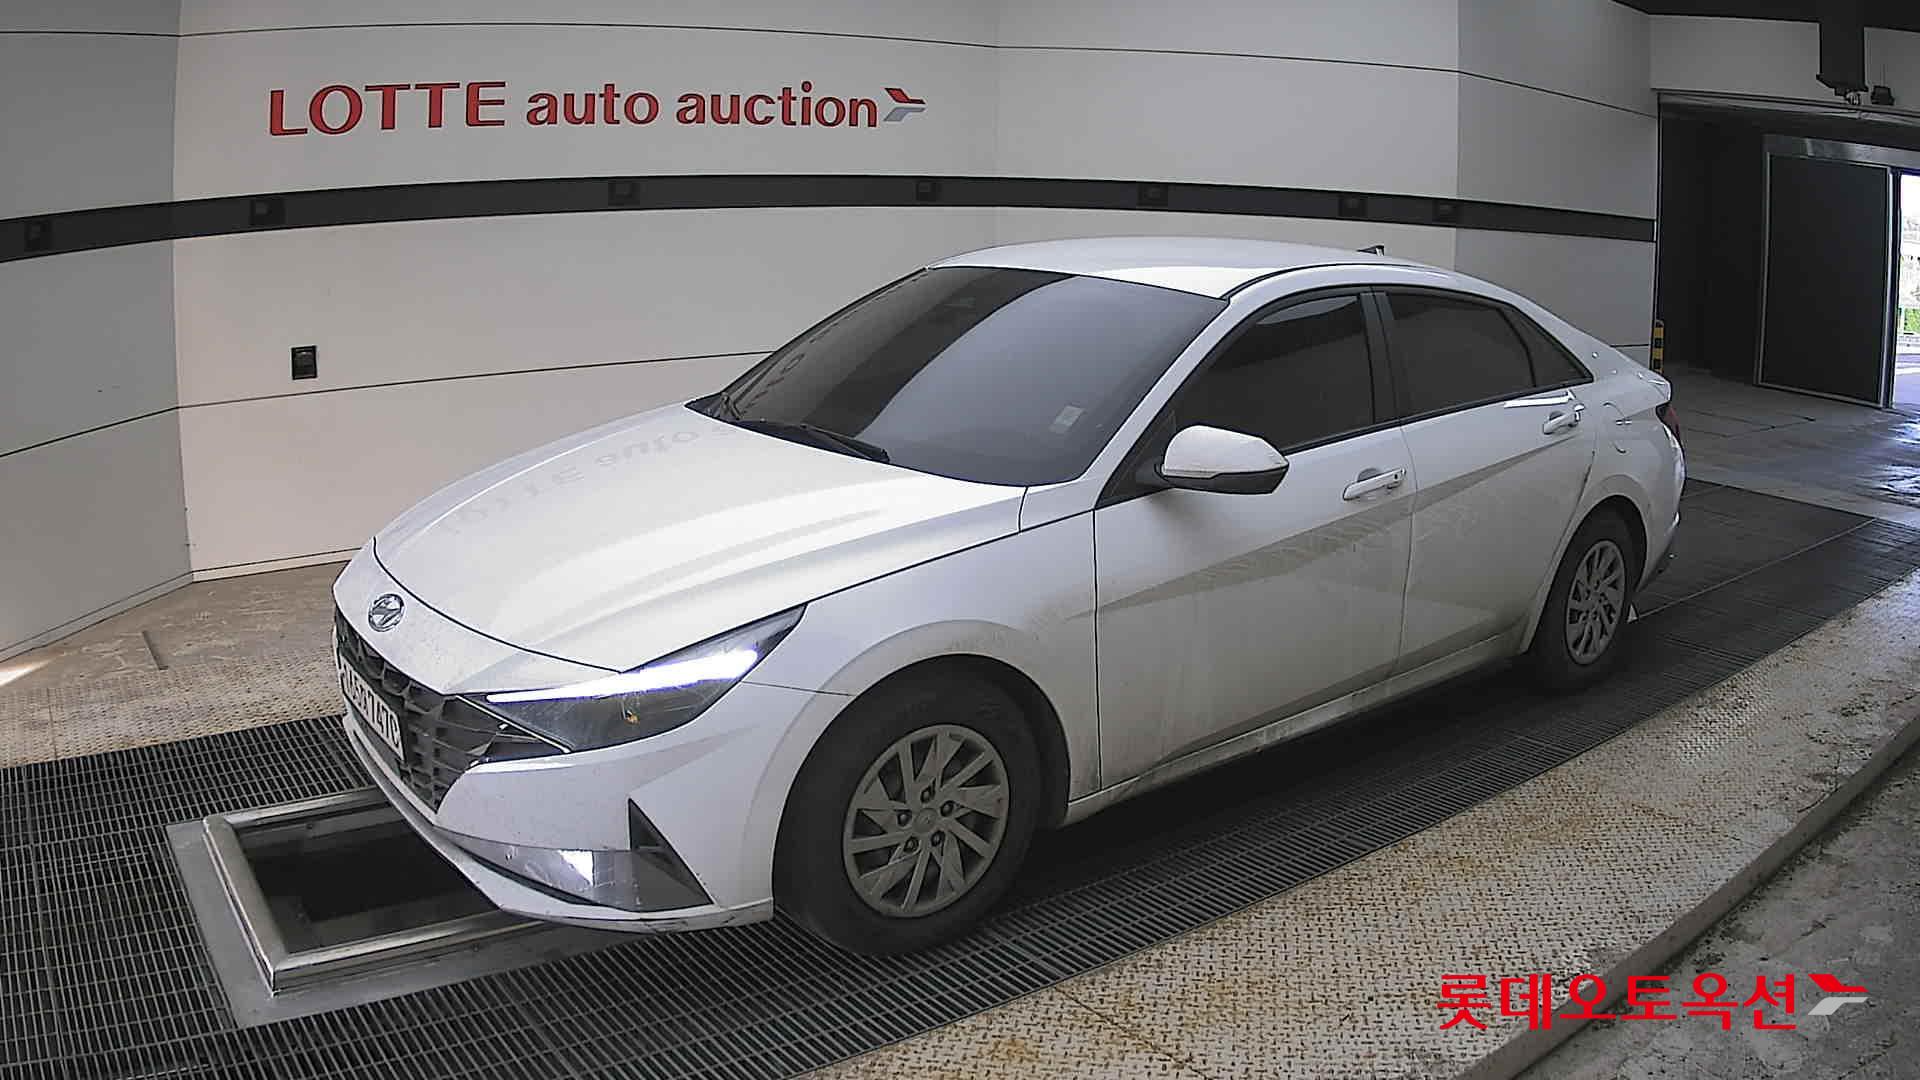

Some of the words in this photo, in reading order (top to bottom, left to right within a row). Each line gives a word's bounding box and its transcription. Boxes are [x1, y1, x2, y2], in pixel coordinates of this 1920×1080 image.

[269, 81, 506, 136] LOTTE
[526, 83, 660, 126] auto
[676, 81, 879, 128] auction
